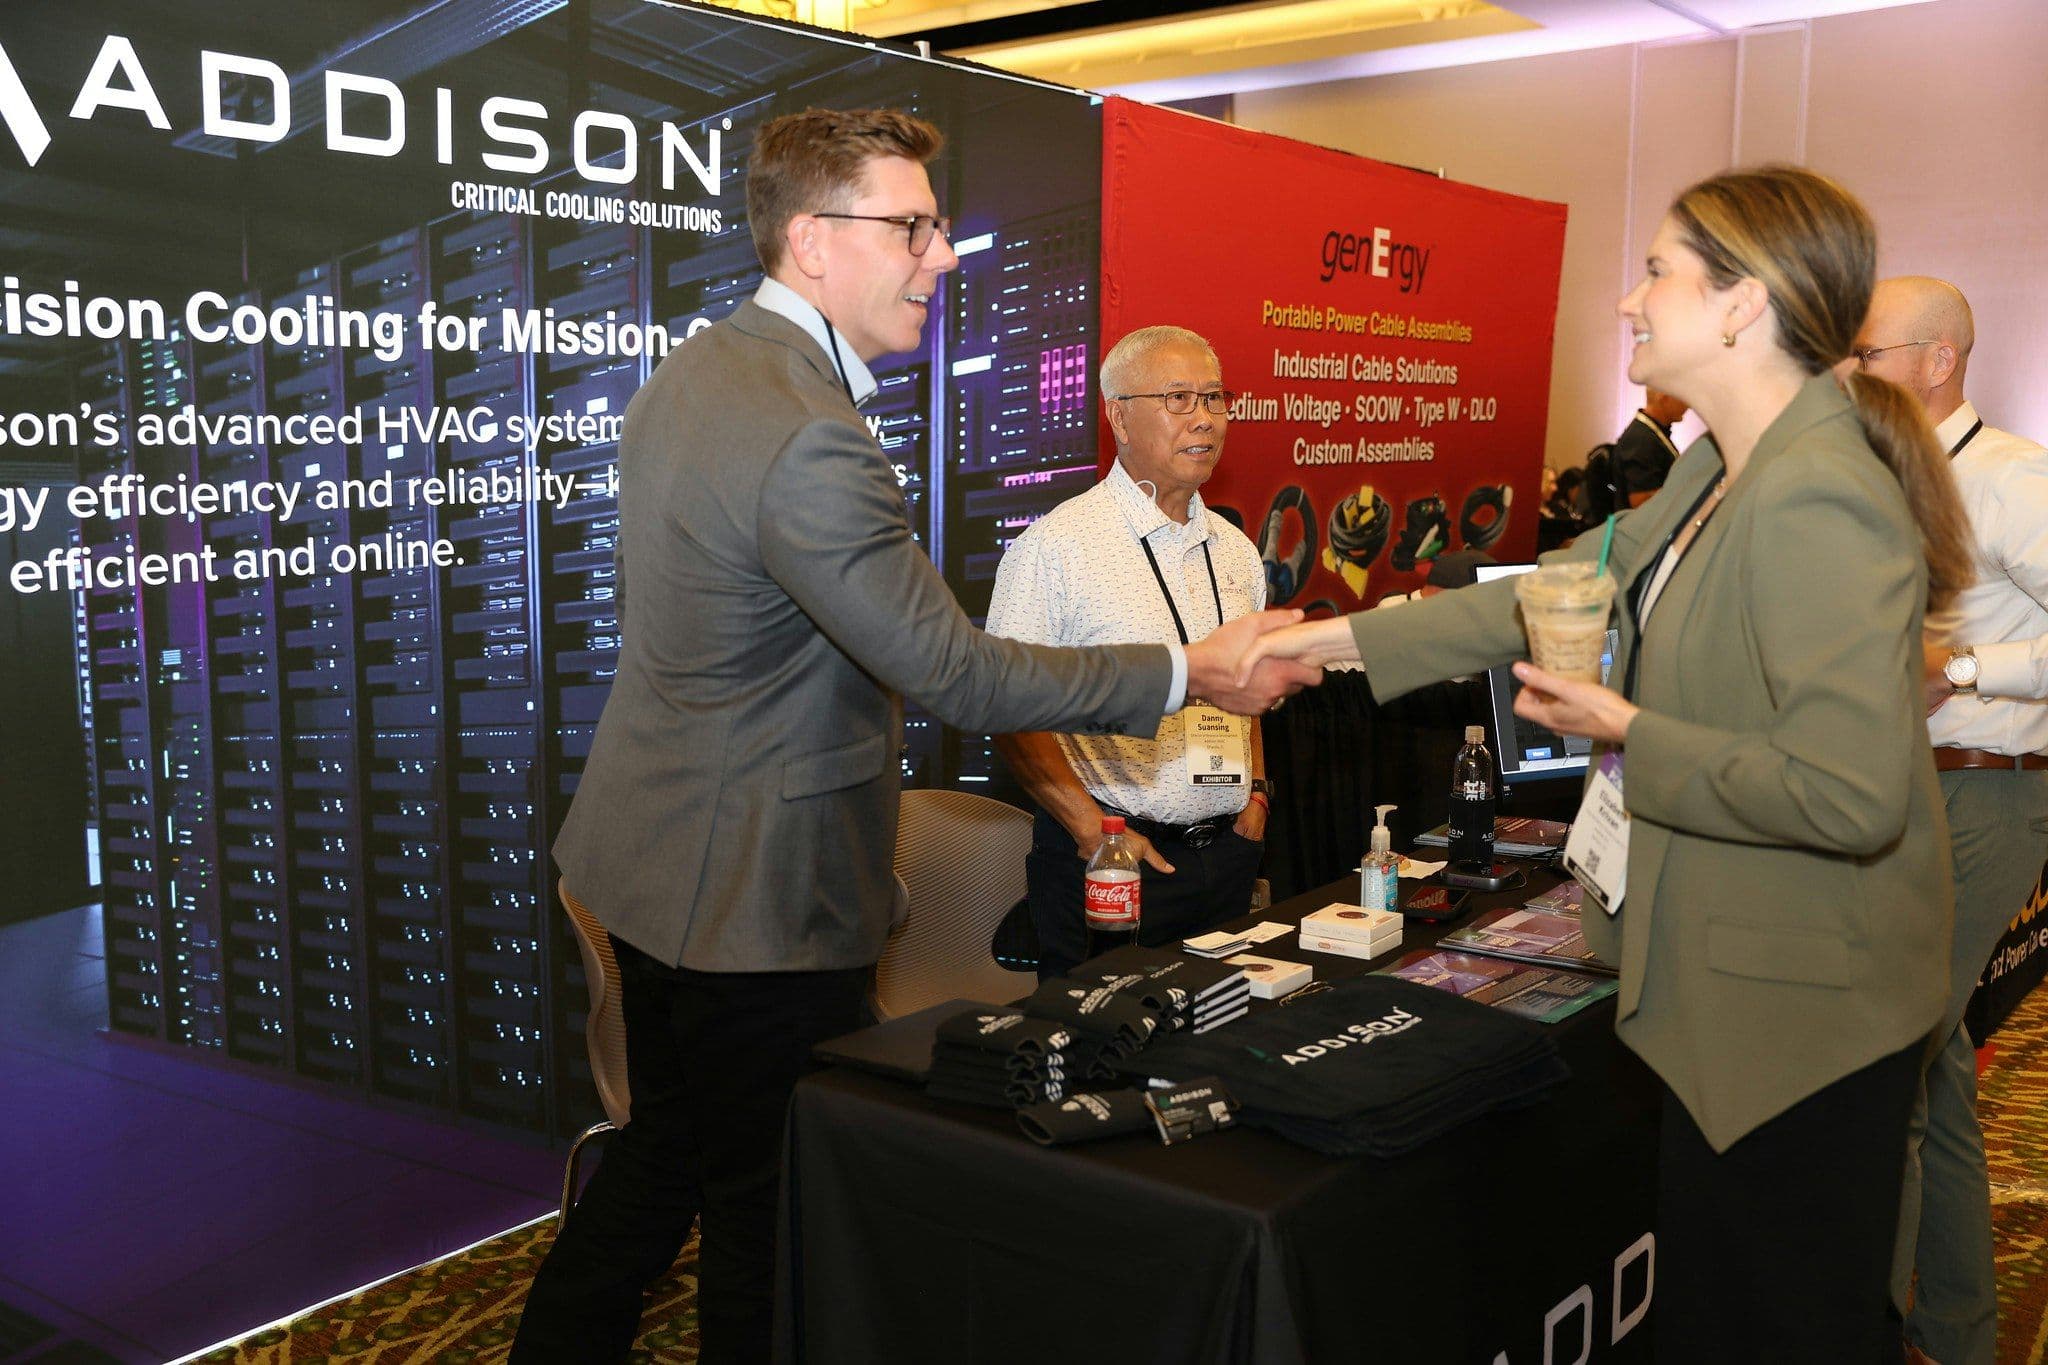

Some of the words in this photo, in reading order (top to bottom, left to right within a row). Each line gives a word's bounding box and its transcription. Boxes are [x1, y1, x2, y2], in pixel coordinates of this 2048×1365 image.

[69, 34, 722, 196] ADDISON
[451, 181, 541, 215] CRITICAL
[545, 192, 625, 224] COOLING
[629, 201, 722, 233] SOLUTIONS
[1320, 227, 1430, 294] genErgy
[0, 276, 166, 340] ision
[185, 290, 405, 362] Cooling
[417, 301, 488, 352] for
[1262, 300, 1323, 330] Portable
[1326, 307, 1367, 335] Power
[1370, 311, 1406, 338] Cable
[1406, 316, 1473, 343] Assemblies
[1273, 349, 1348, 380] Industrial
[1352, 353, 1393, 383] Cable
[1396, 357, 1458, 386] Solutions
[137, 403, 363, 447] advanced
[377, 406, 495, 444] HVAC
[1226, 392, 1278, 421] edium
[1283, 393, 1342, 428] Voltage
[1355, 395, 1402, 422] SOOW
[1414, 397, 1445, 427] Type
[1447, 398, 1461, 421] W
[1470, 397, 1497, 421] DLO
[1293, 437, 1352, 465] Custom
[1356, 437, 1435, 464] Assemblies
[67, 473, 301, 522] efficiency
[316, 471, 394, 511] and
[10, 543, 218, 595] efficient
[233, 538, 316, 579] and
[330, 534, 465, 576] online.
[1197, 723, 1230, 732] Suansing
[1201, 714, 1224, 723] Danny
[1281, 1007, 1412, 1066] ADDISON
